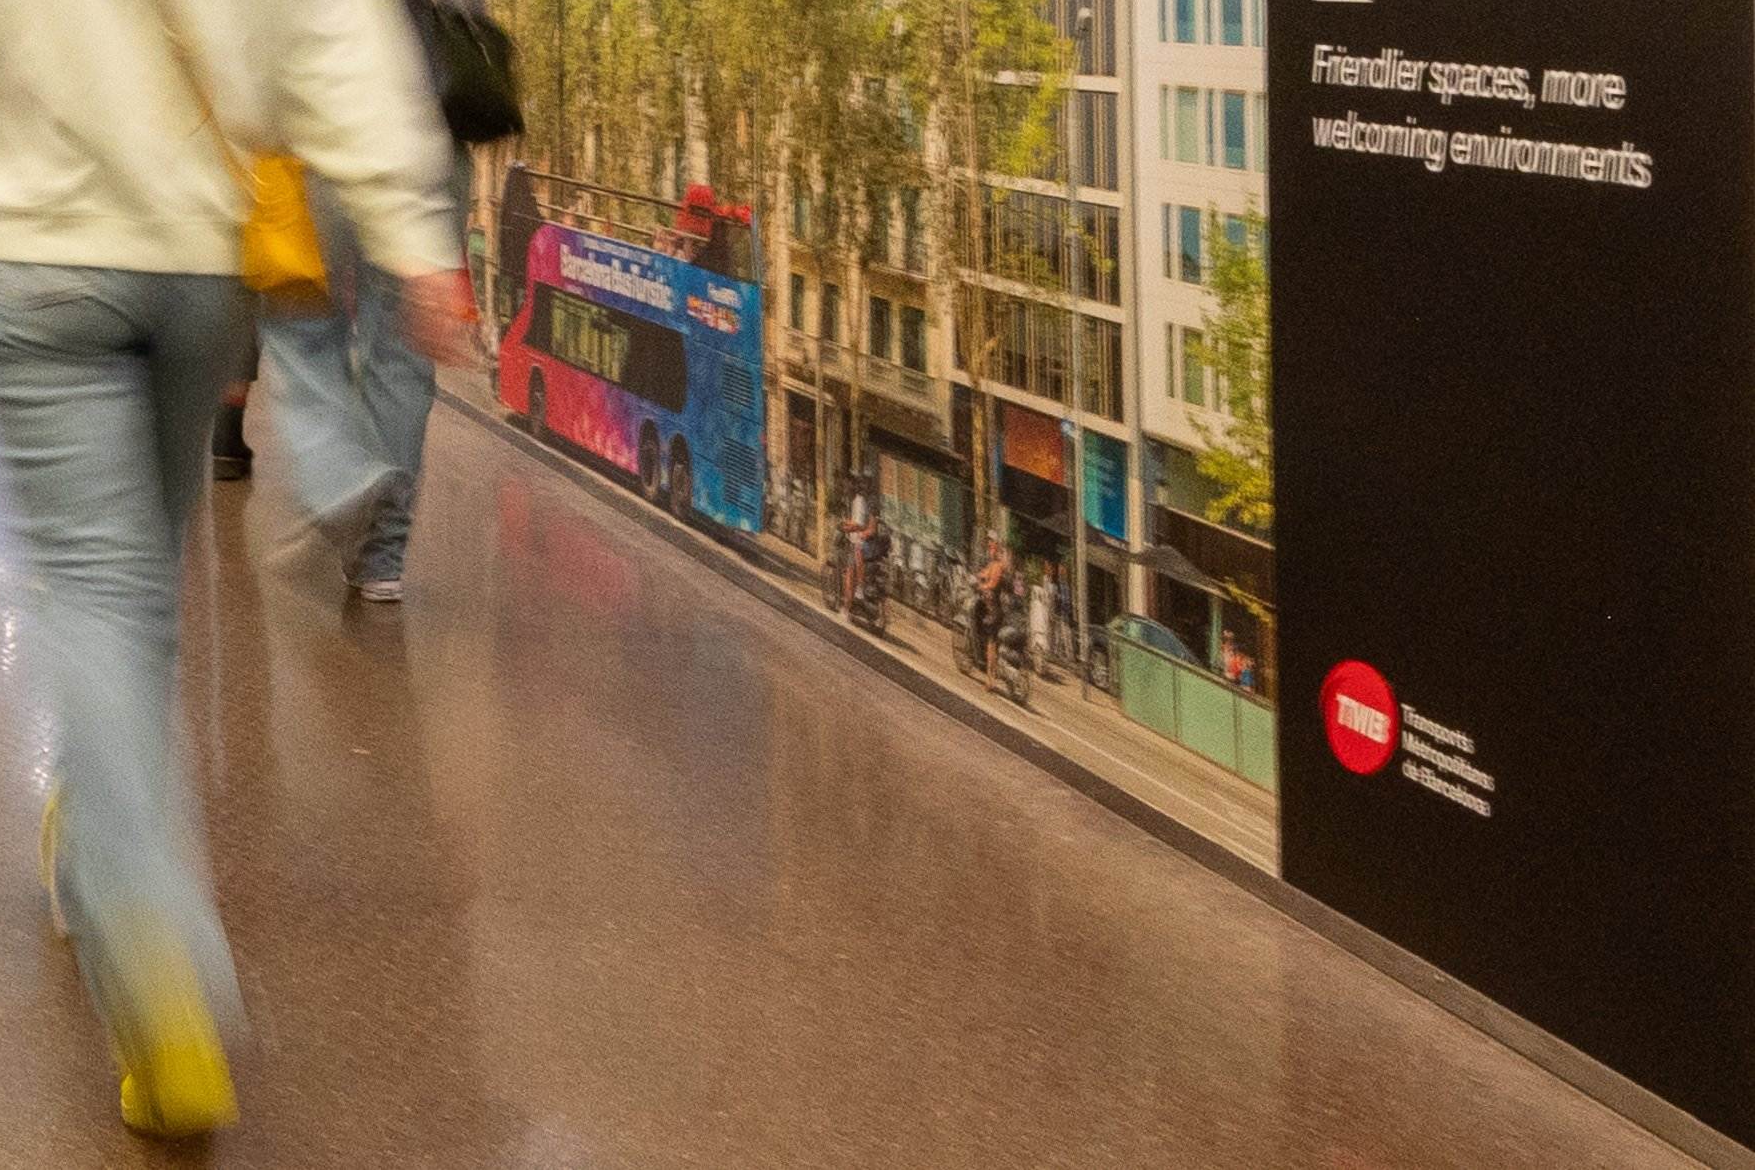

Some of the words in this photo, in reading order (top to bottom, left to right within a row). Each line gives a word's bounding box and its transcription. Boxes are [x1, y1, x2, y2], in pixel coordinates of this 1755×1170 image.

[1311, 43, 1428, 91] Friendlier
[1428, 61, 1536, 109] spaces,
[1541, 69, 1626, 110] more
[1312, 110, 1447, 172] welcoming
[1450, 125, 1653, 188] environments
